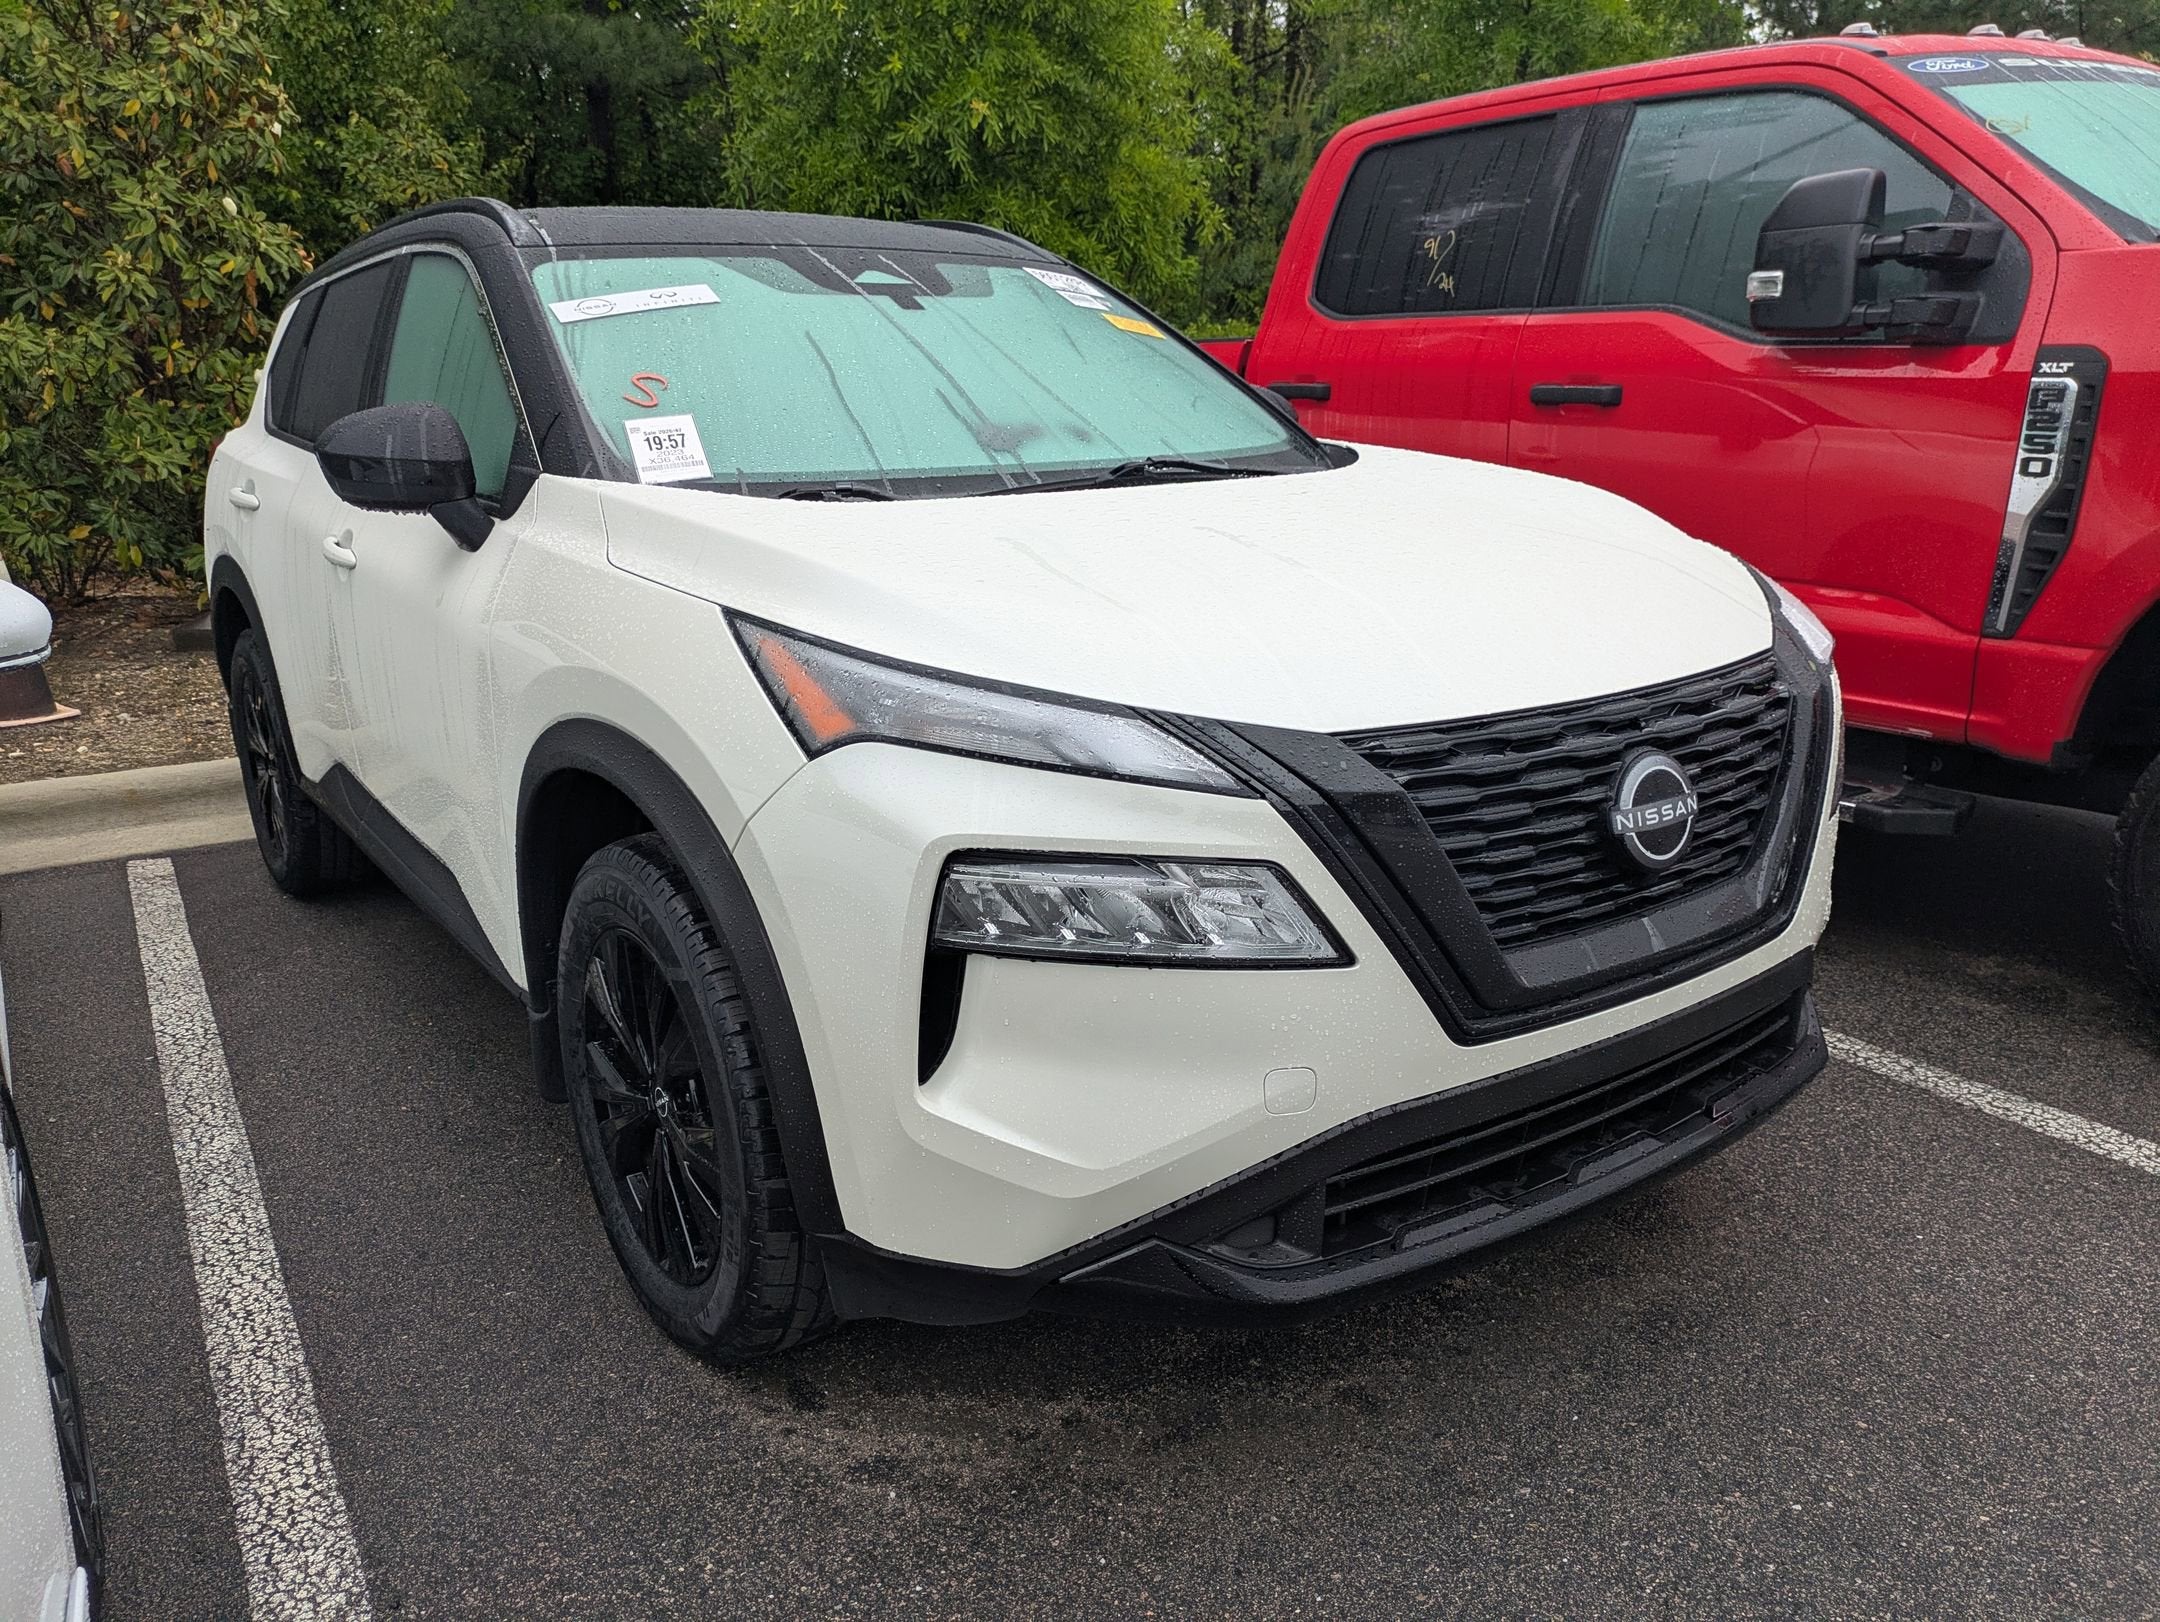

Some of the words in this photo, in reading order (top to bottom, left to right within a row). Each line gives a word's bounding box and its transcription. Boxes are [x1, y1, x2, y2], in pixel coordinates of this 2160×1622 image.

[1925, 60, 1975, 71] Ford
[573, 302, 617, 312] NISSAN
[2038, 362, 2074, 373] XLT
[623, 372, 668, 408] S
[643, 433, 685, 451] 19:57
[1615, 795, 1698, 831] NISSAN
